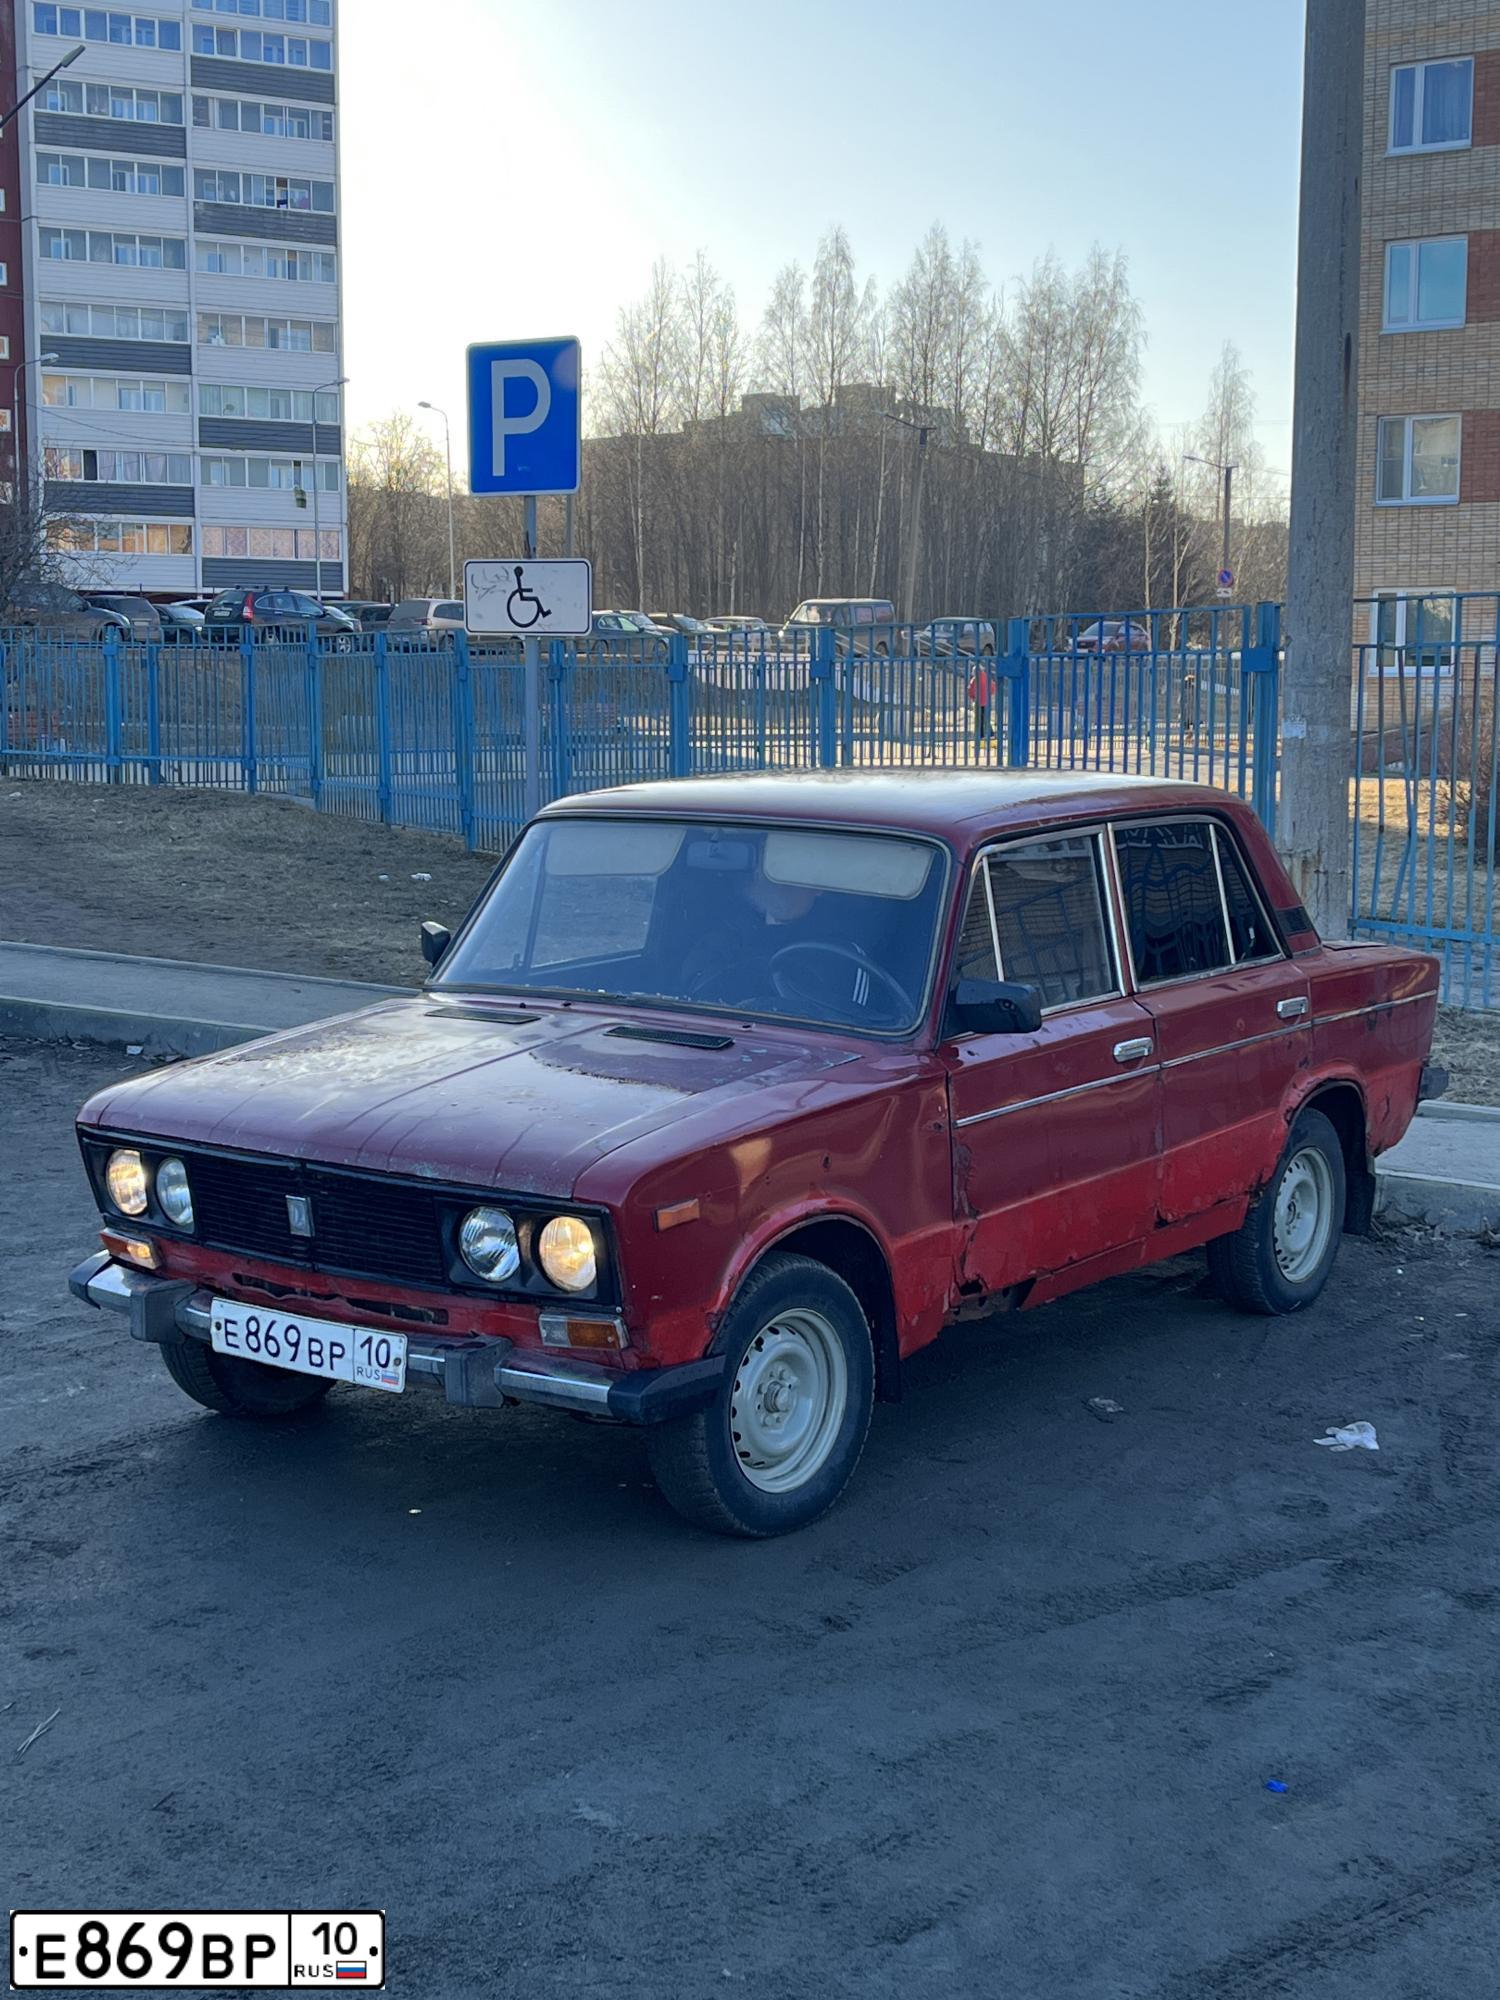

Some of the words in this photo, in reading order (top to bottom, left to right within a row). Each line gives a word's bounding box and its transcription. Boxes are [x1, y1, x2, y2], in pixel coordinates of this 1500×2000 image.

[491, 358, 551, 477] P
[360, 1335, 391, 1369] 10
[356, 1366, 381, 1381] RUS
